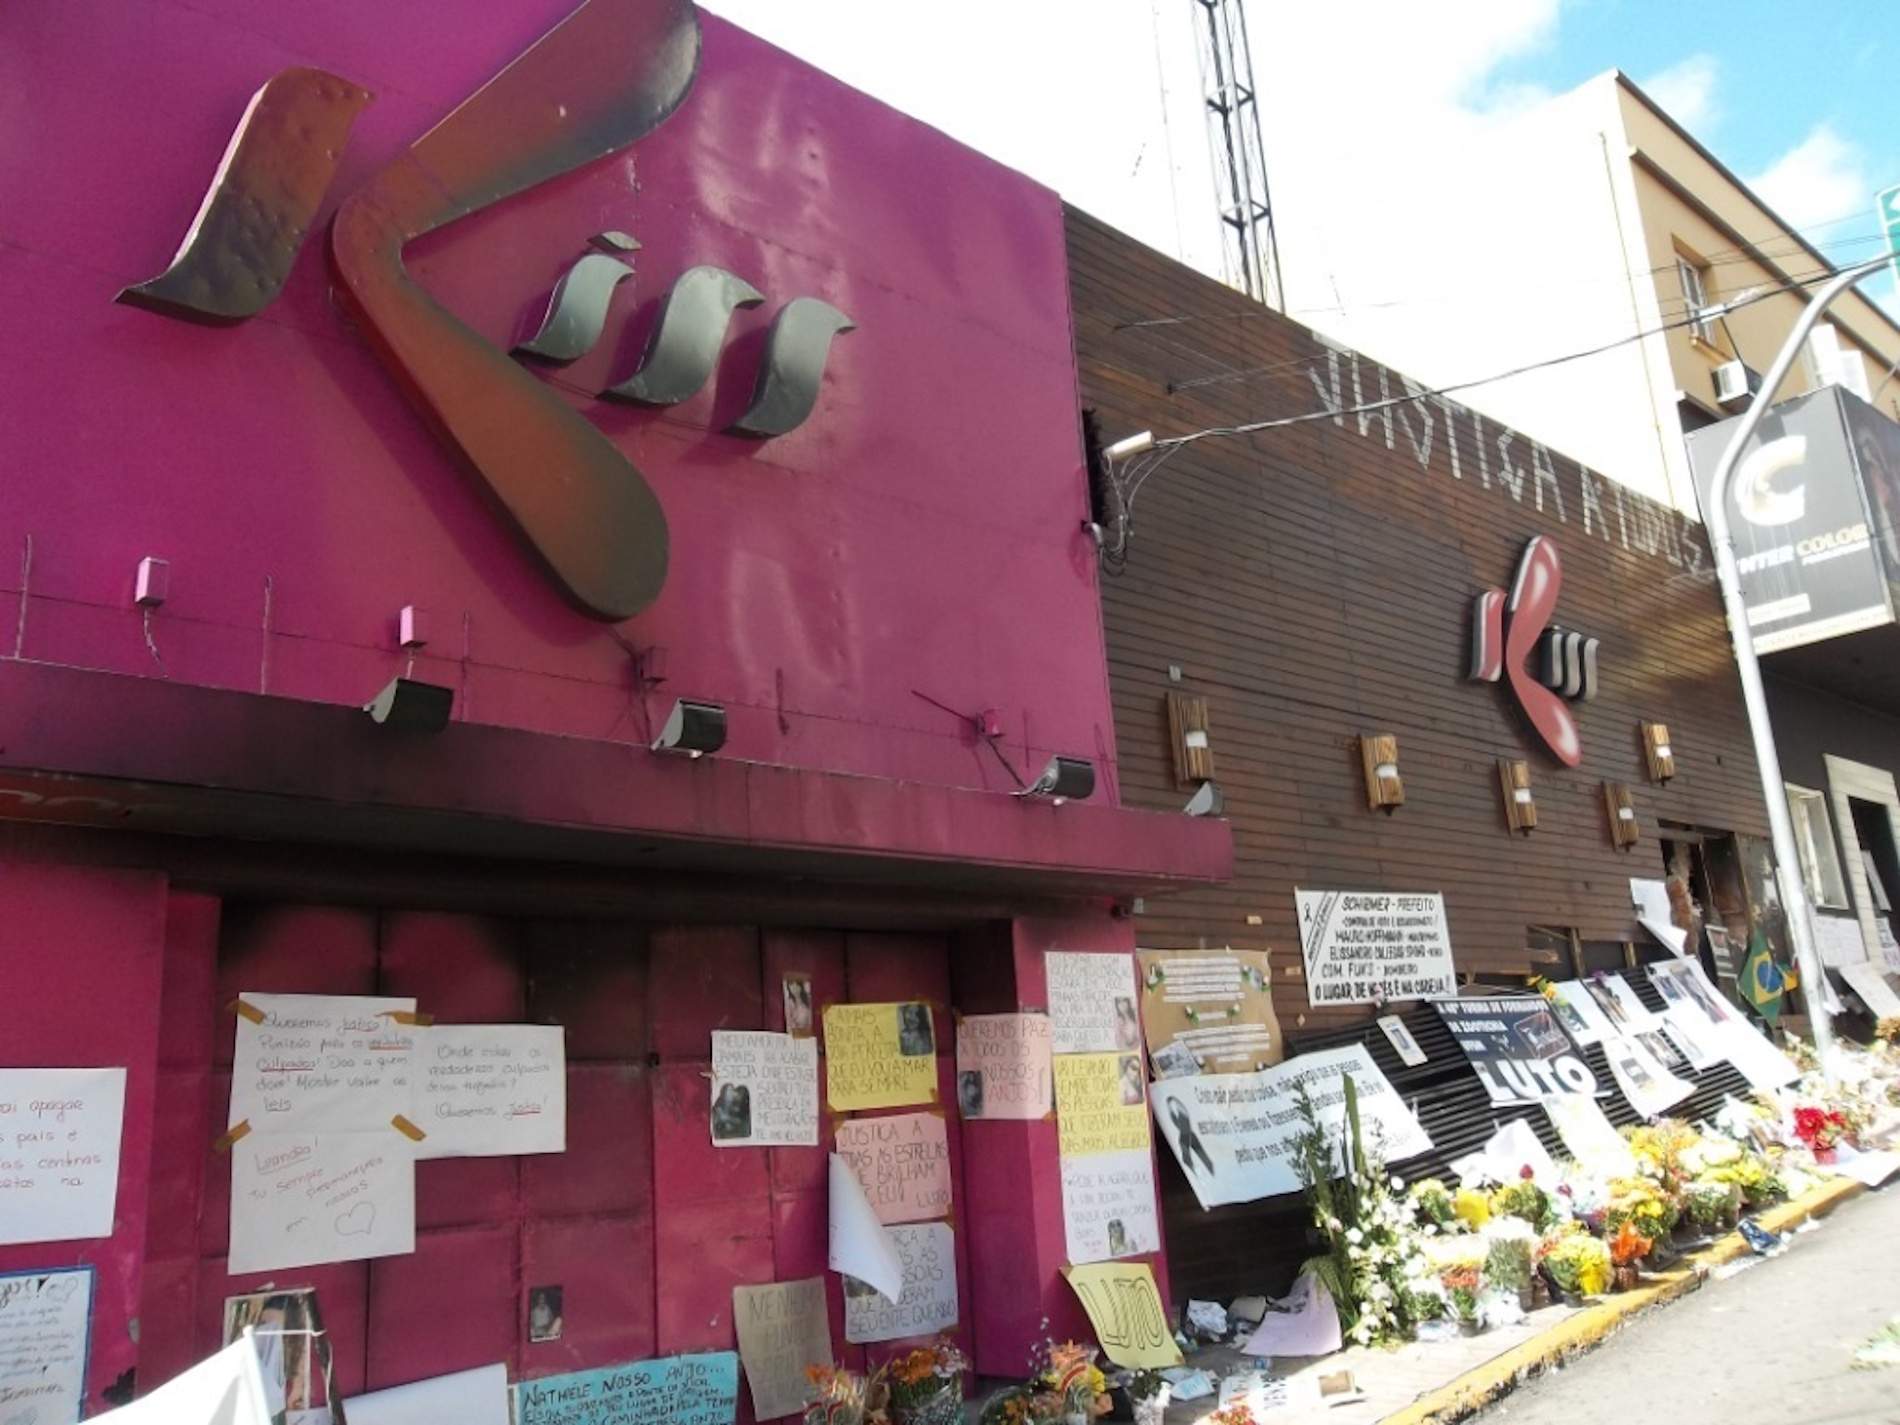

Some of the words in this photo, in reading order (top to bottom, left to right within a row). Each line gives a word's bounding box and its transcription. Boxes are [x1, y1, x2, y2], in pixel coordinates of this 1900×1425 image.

[1022, 1017, 1050, 1037] PAZ
[1471, 1055, 1598, 1100] LUTO
[1077, 1276, 1165, 1351] LUTO
[602, 1372, 652, 1393] NOSSO
